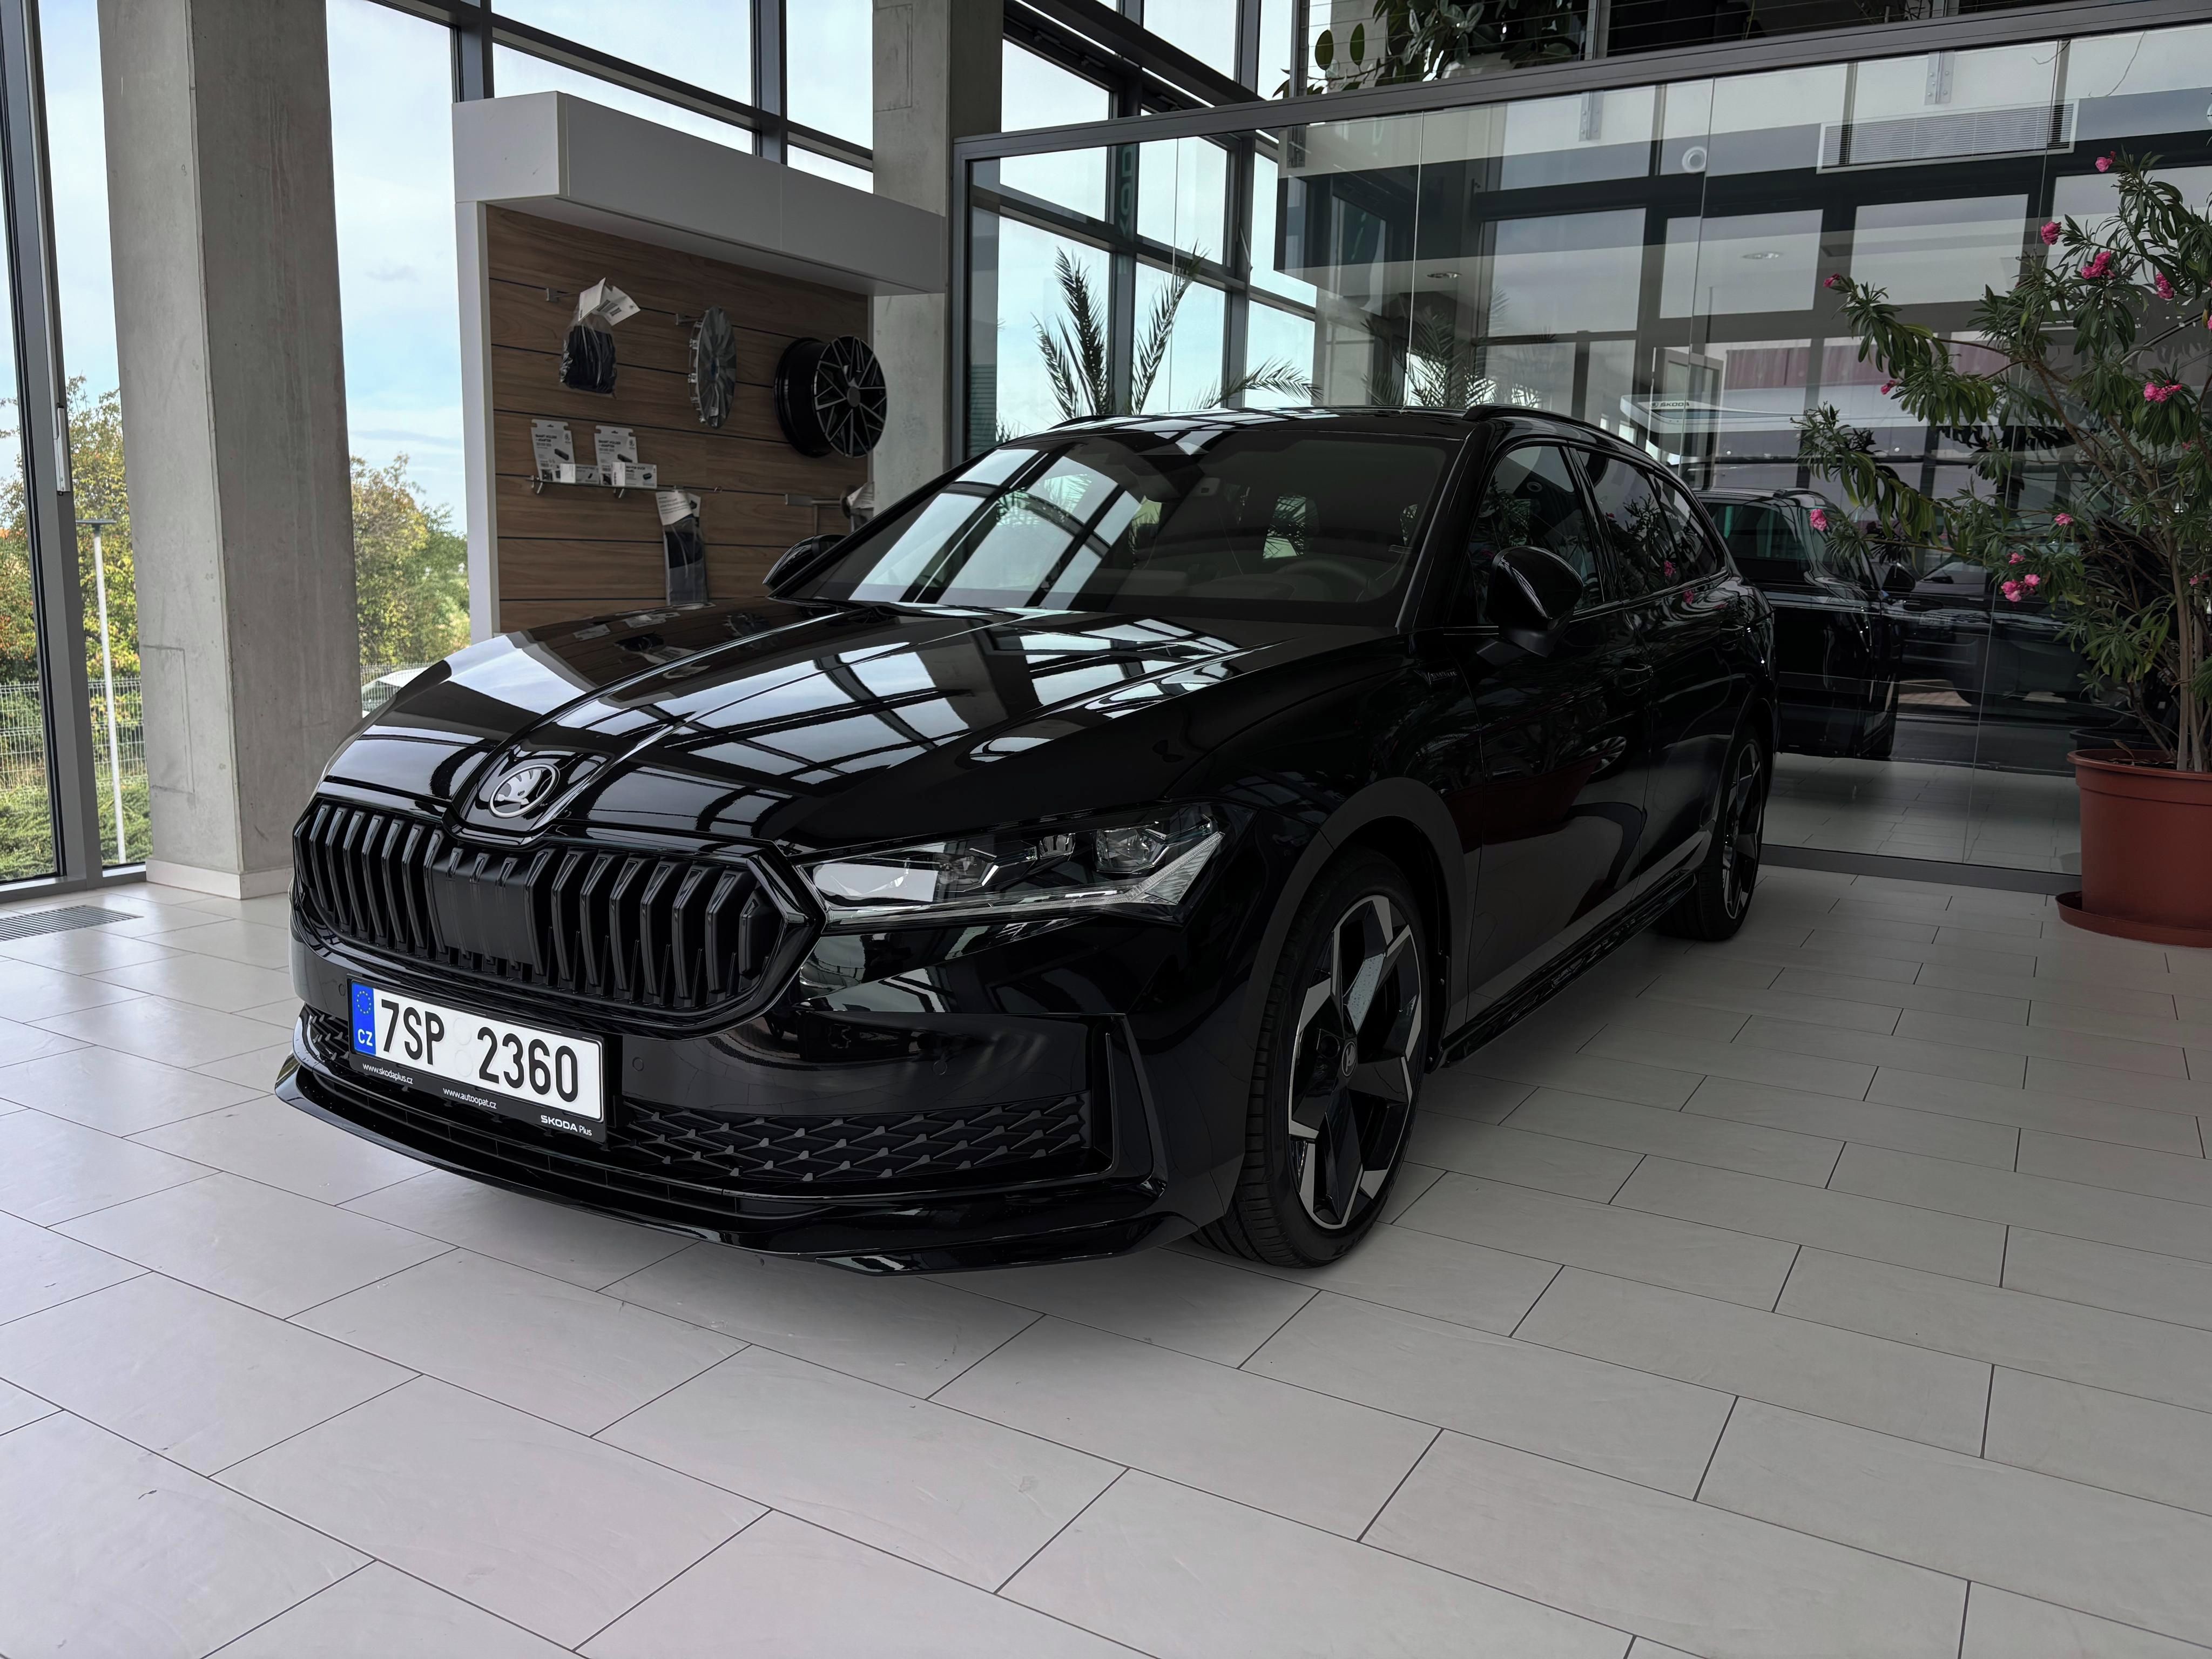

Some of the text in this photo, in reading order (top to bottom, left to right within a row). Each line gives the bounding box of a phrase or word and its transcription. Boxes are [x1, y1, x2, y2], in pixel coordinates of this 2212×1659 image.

[358, 1028, 373, 1047] CZ
[381, 999, 578, 1103] 7SP 2360
[362, 1063, 414, 1084] www.skodaplus.cz
[442, 1088, 497, 1109] www.autoopat.cz
[579, 1125, 592, 1136] Plus
